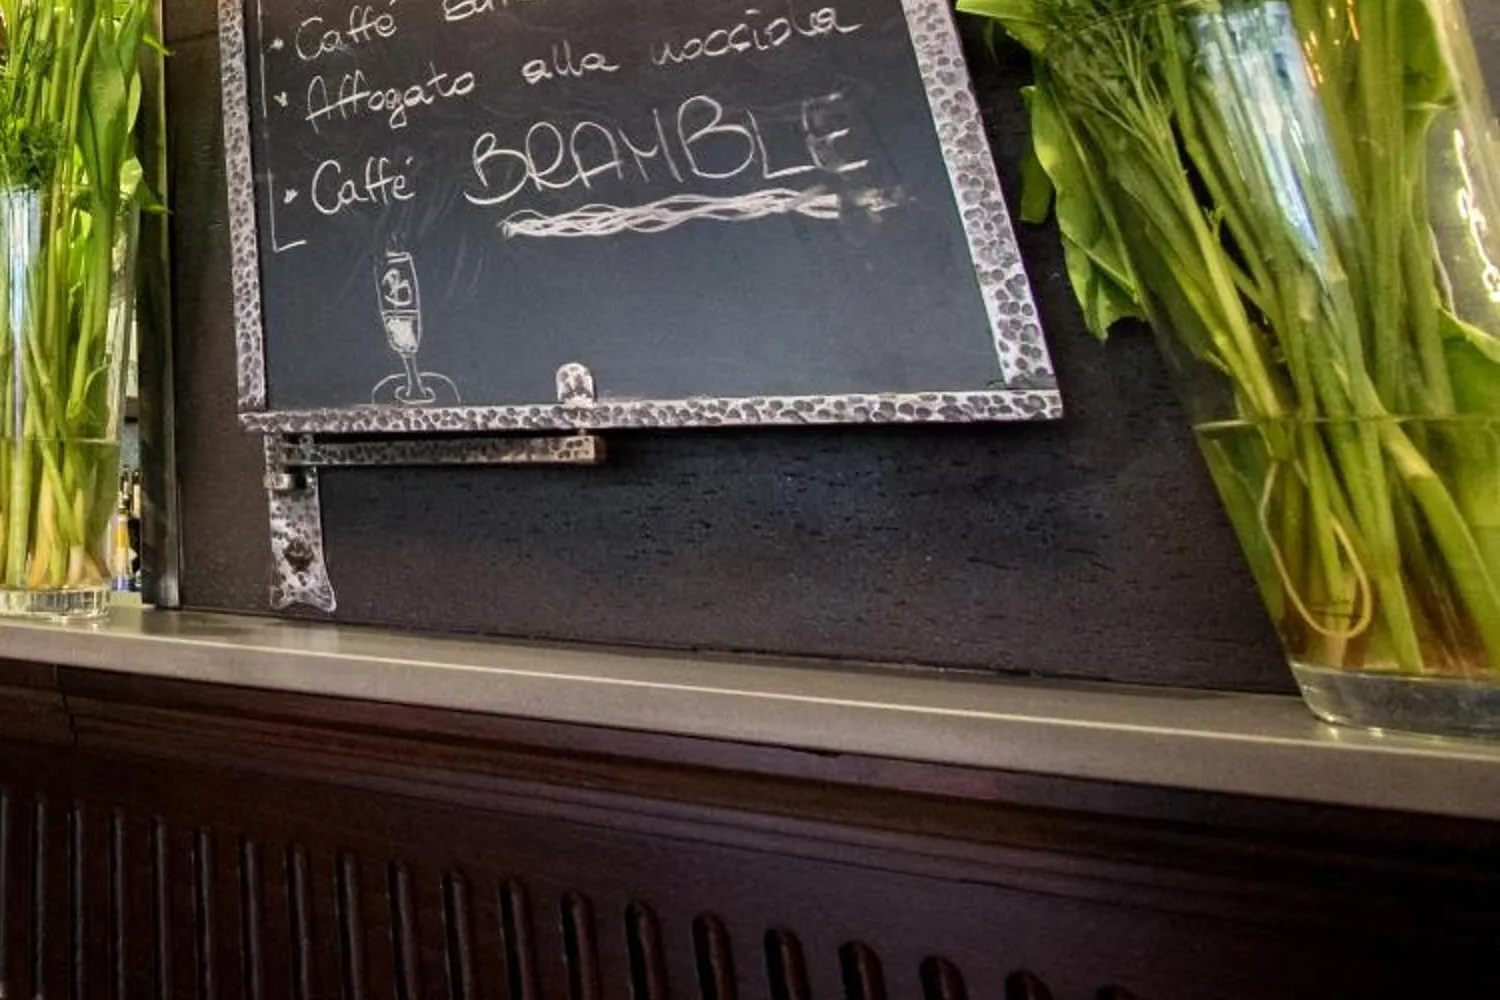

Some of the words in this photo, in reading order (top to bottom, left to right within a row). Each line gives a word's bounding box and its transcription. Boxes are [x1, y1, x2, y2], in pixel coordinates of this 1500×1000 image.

[305, 62, 476, 134] Affogato
[521, 39, 620, 84] alla
[464, 92, 869, 204] BRAMBLE
